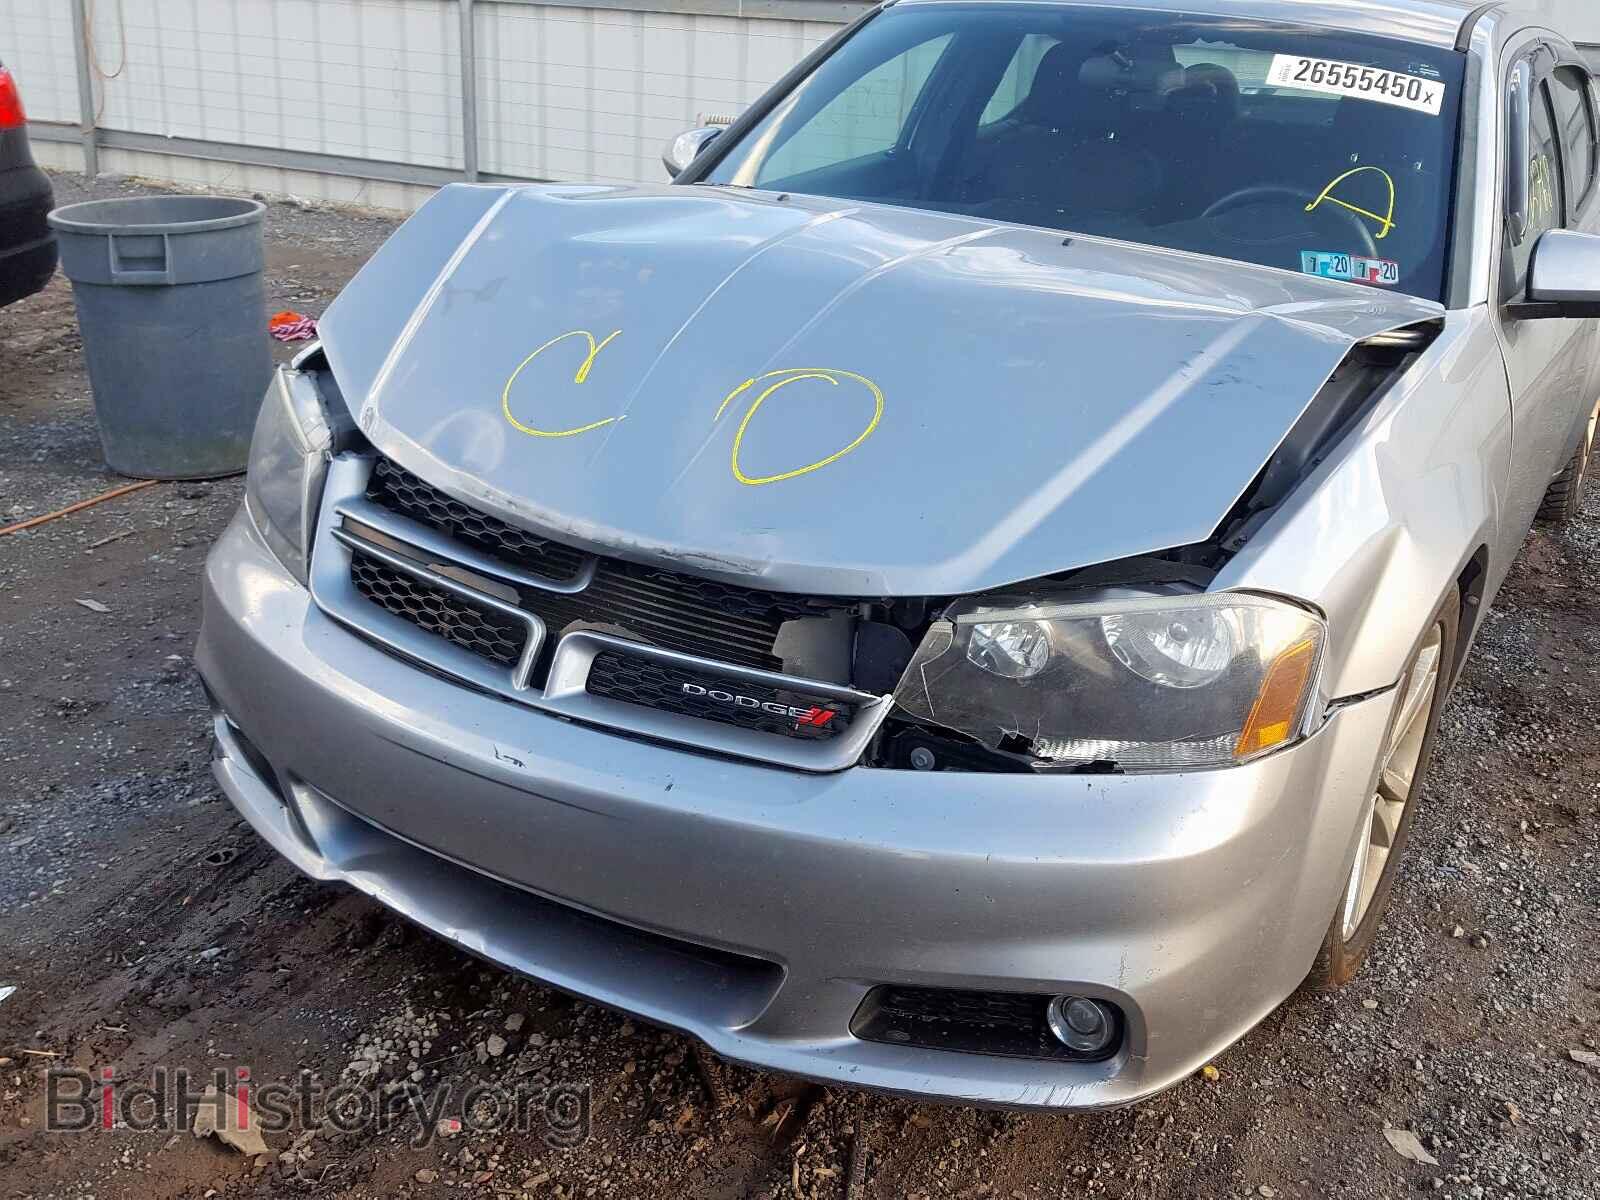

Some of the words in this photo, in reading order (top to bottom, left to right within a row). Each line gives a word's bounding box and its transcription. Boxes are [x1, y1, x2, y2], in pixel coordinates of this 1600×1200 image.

[1305, 166, 1396, 240] A
[1334, 255, 1348, 273] 20
[1383, 263, 1397, 280] 20
[682, 683, 814, 721] DODGE
